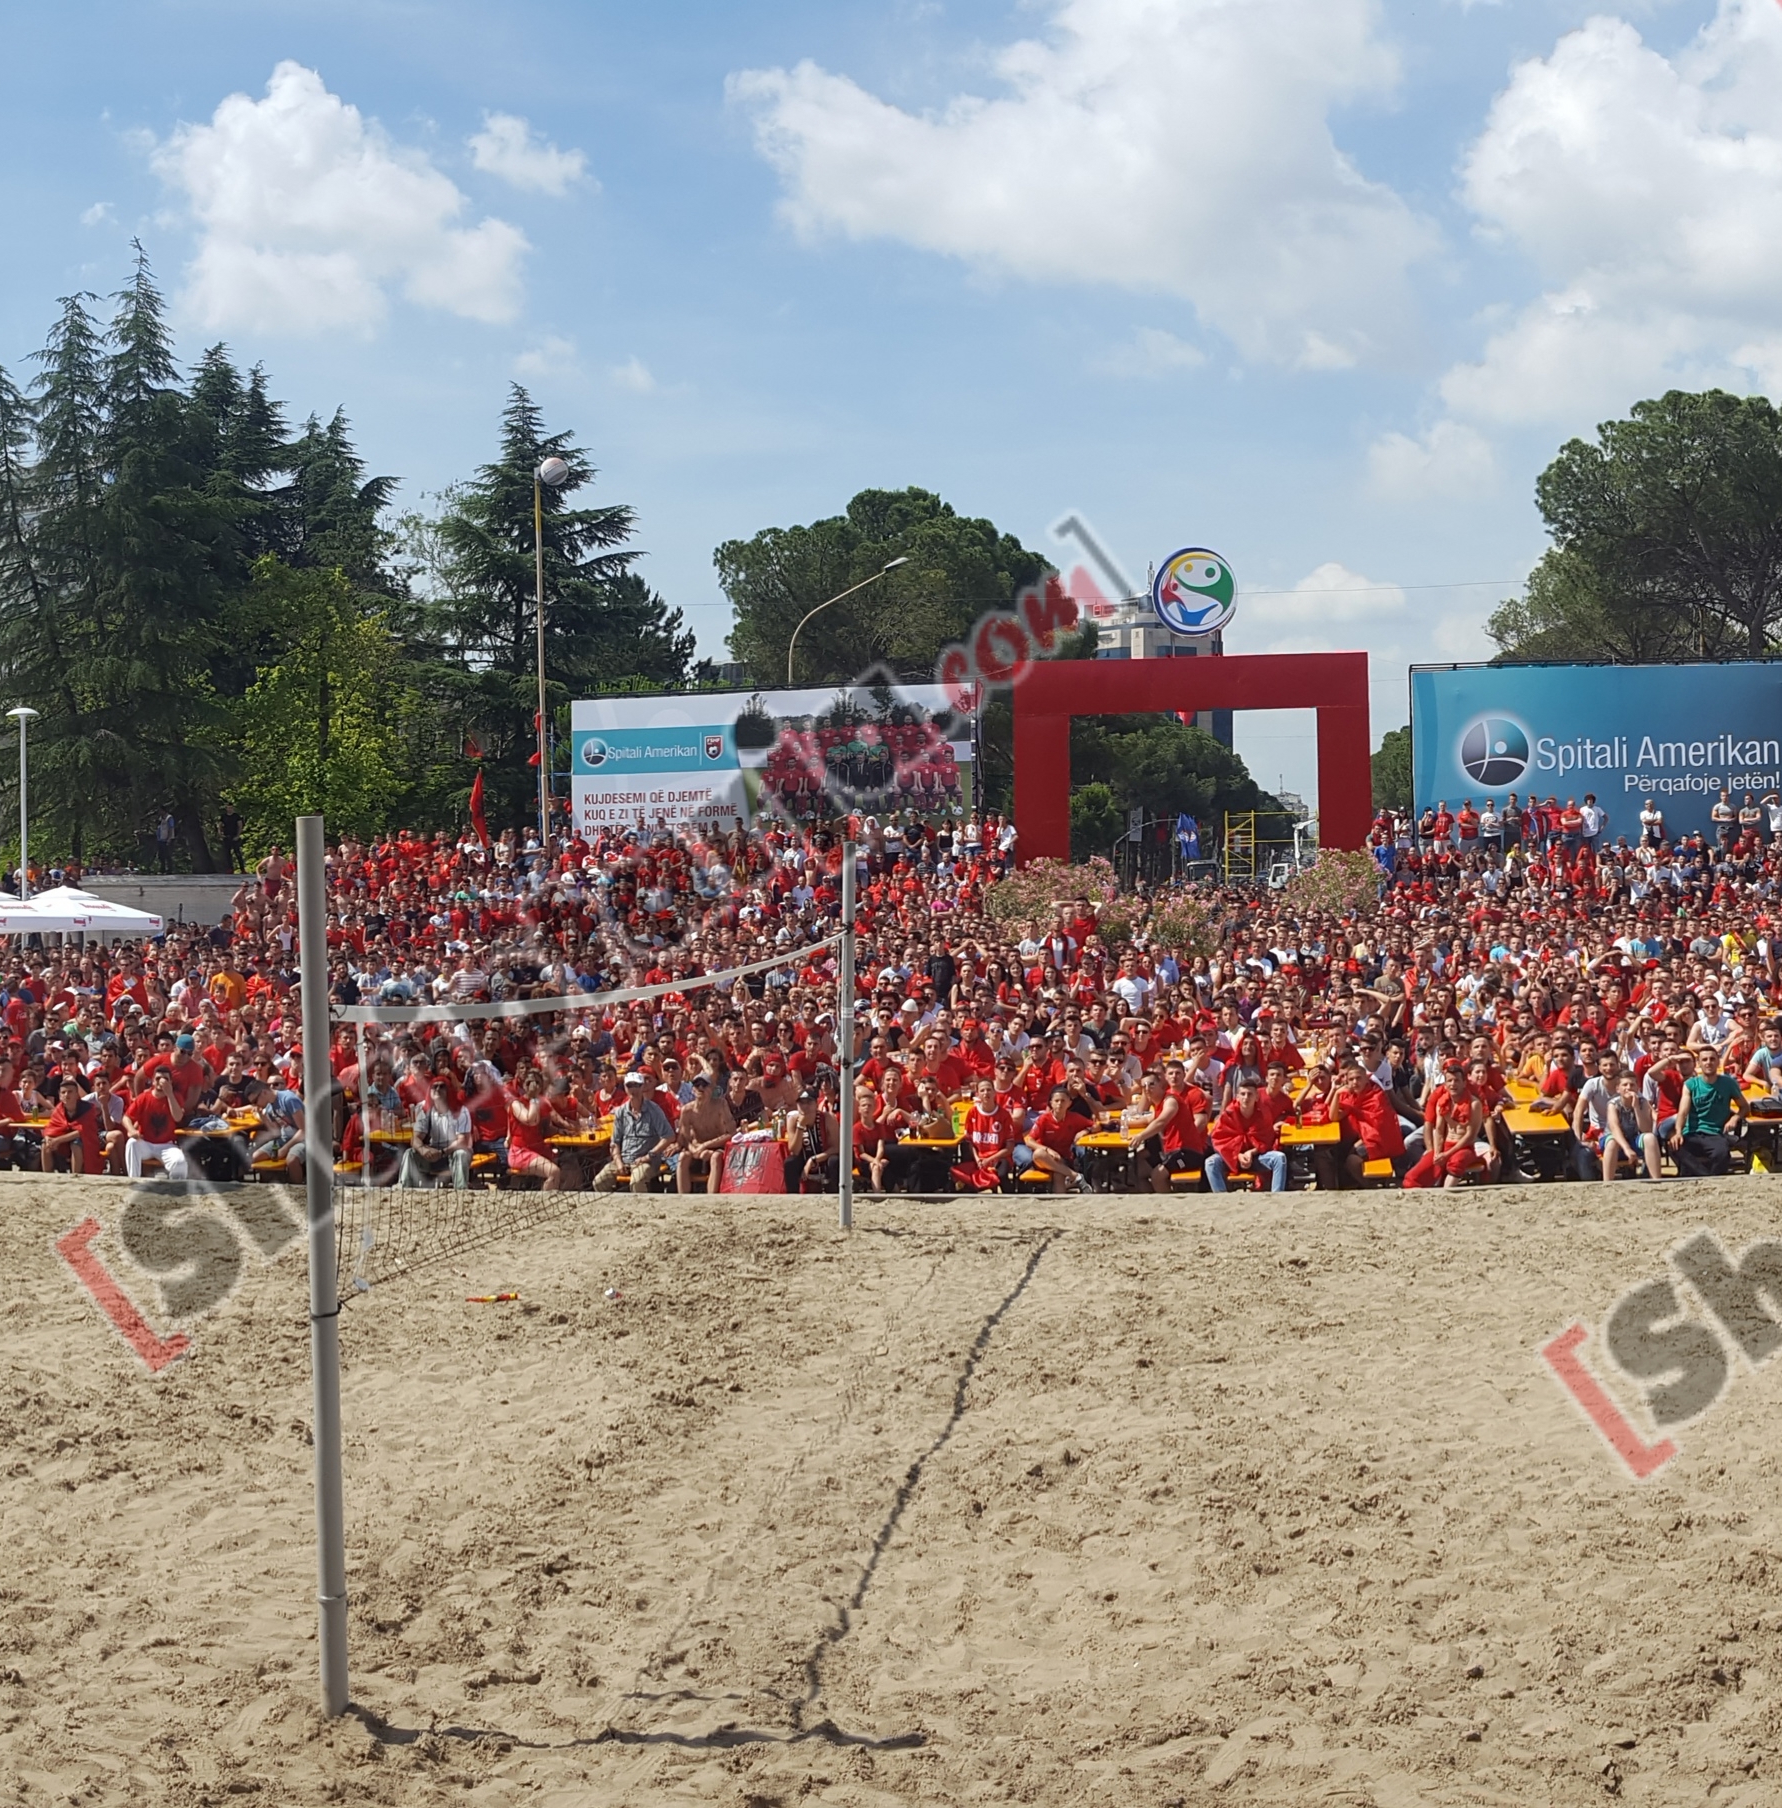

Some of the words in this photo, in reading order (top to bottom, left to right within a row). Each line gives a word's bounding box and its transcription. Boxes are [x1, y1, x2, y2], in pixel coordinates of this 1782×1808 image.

[608, 747, 642, 761] Spitali
[644, 746, 697, 758] Amerikan
[1536, 736, 1627, 777] Spitali
[1636, 735, 1781, 768] Amerikan
[1624, 773, 1721, 796] Përqafoje
[1726, 770, 1781, 795] jetën!
[584, 793, 646, 805] KUJDESEMI
[650, 789, 664, 803] QË
[668, 787, 712, 802] DJEMTË
[584, 809, 606, 820] KUQ
[609, 809, 615, 819] E
[618, 808, 629, 819] ZI
[632, 805, 646, 818] TË
[649, 805, 677, 818] JENË
[680, 803, 695, 817] NË
[698, 802, 738, 817] FORMË
